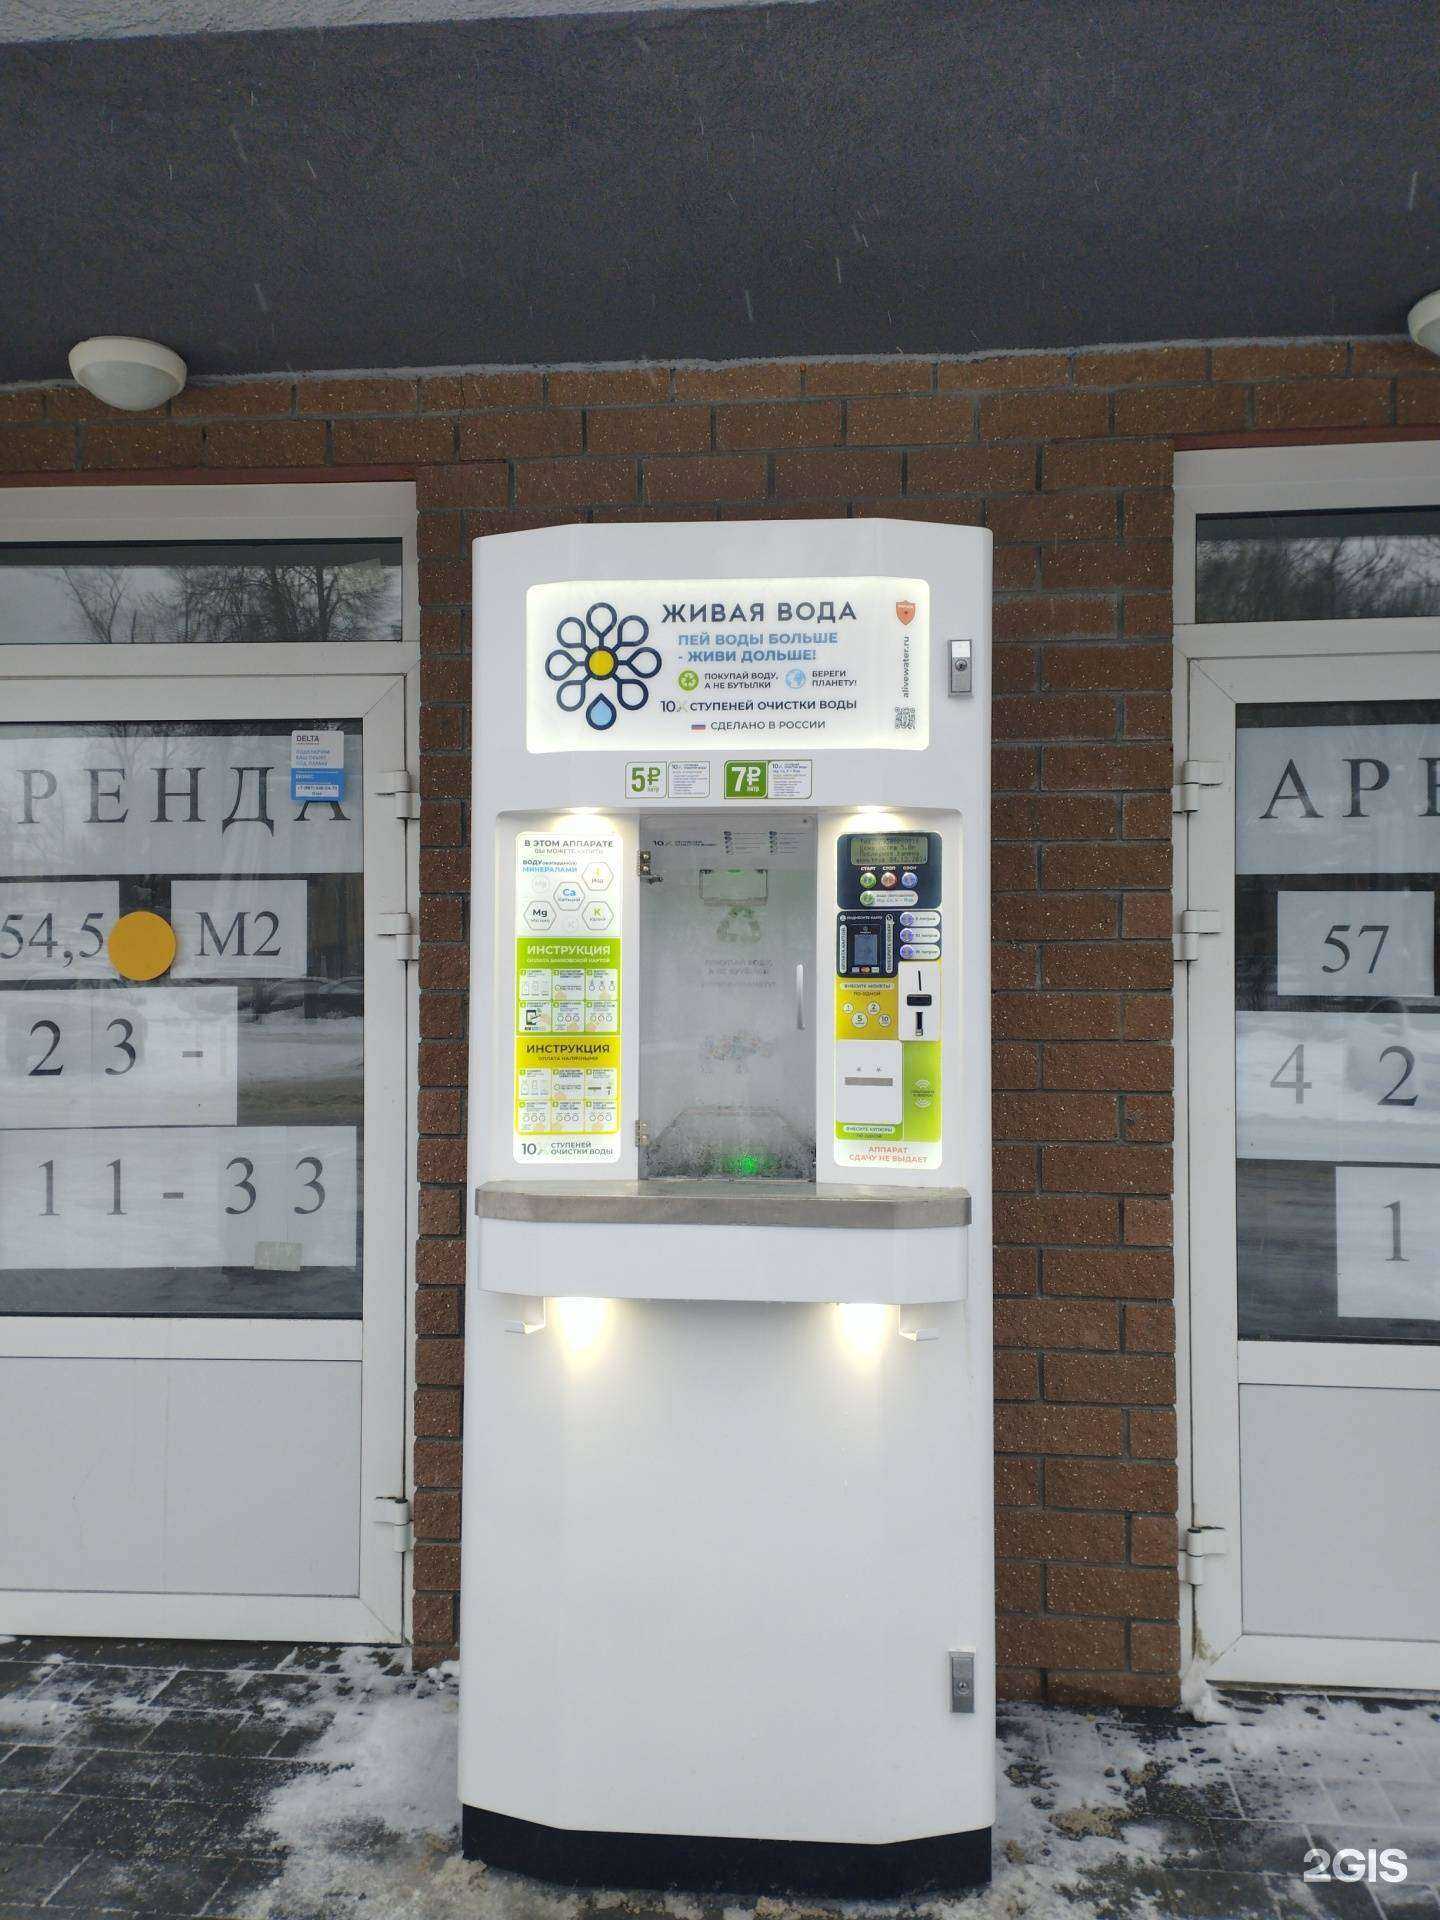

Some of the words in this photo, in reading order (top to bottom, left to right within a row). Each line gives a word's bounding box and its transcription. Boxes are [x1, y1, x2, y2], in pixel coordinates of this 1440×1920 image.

[661, 602, 765, 623] ЖИВАЯ
[777, 601, 857, 624] ВОДА
[678, 632, 710, 646] ПЕЙ
[715, 633, 764, 647] ВОДЫ
[768, 632, 838, 645] БОЛЬШЕ
[688, 650, 736, 662] ЖИВИ
[740, 649, 817, 663] ДОЛЬШЕ!
[902, 636, 910, 698] alivewater.ru
[704, 671, 749, 680] ПОКУПАЙ
[812, 670, 847, 678] БЕРЕГИ
[727, 681, 771, 689] БУТЫЛКИ
[812, 679, 857, 687] ПЛАНЕТУ!
[660, 700, 676, 712] 10
[690, 699, 754, 712] СТУПЕНЕЙ
[757, 700, 816, 710] ОЧИСТКИ
[819, 700, 857, 711] ВОДЫ
[710, 721, 766, 731] СДЕЛАНО
[769, 722, 776, 730] В
[779, 720, 826, 730] РОССИИ
[533, 839, 560, 847] ЭТОМ
[562, 840, 613, 848] АППАРАТЕ
[562, 888, 577, 897] Ca
[532, 908, 548, 918] Mg
[0, 912, 104, 968] 54,5
[527, 945, 611, 956] ИНСТРУКЦИЯ
[1321, 924, 1390, 974] 57
[526, 1044, 610, 1054] ИНСТРУКЦИЯ
[521, 1143, 537, 1155] 10
[550, 1141, 592, 1149] СТУПЕНЕЙ
[868, 1146, 909, 1154] АППАРАТ
[848, 1153, 878, 1162] СДАЧУ
[892, 1155, 928, 1164] ВЫДАЕТ
